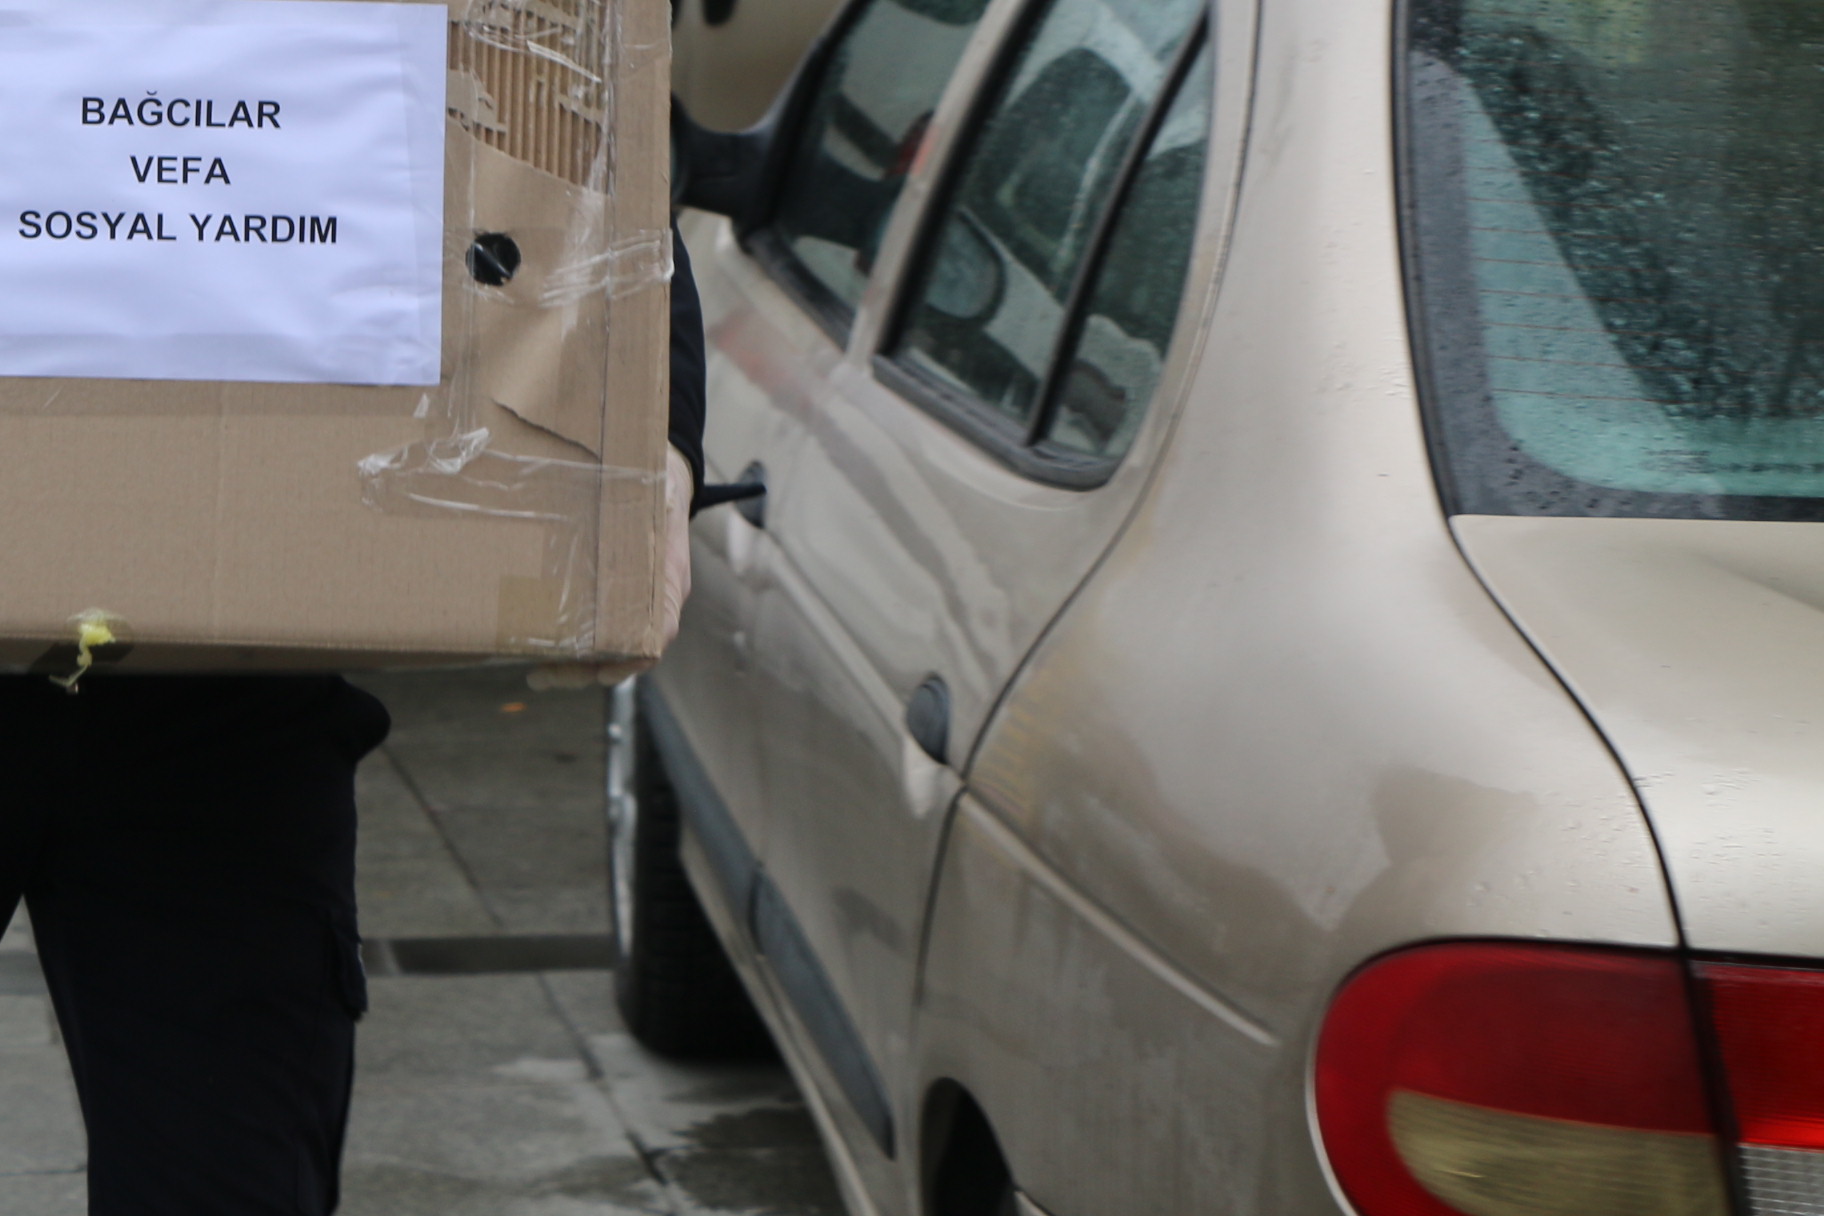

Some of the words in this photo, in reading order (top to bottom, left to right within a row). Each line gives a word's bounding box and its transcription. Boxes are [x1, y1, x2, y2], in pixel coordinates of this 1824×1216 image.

[80, 90, 282, 130] BAĞCILAR
[129, 154, 232, 185] VEFA
[17, 209, 177, 242] SOSYAL
[189, 212, 339, 245] YARDIM
